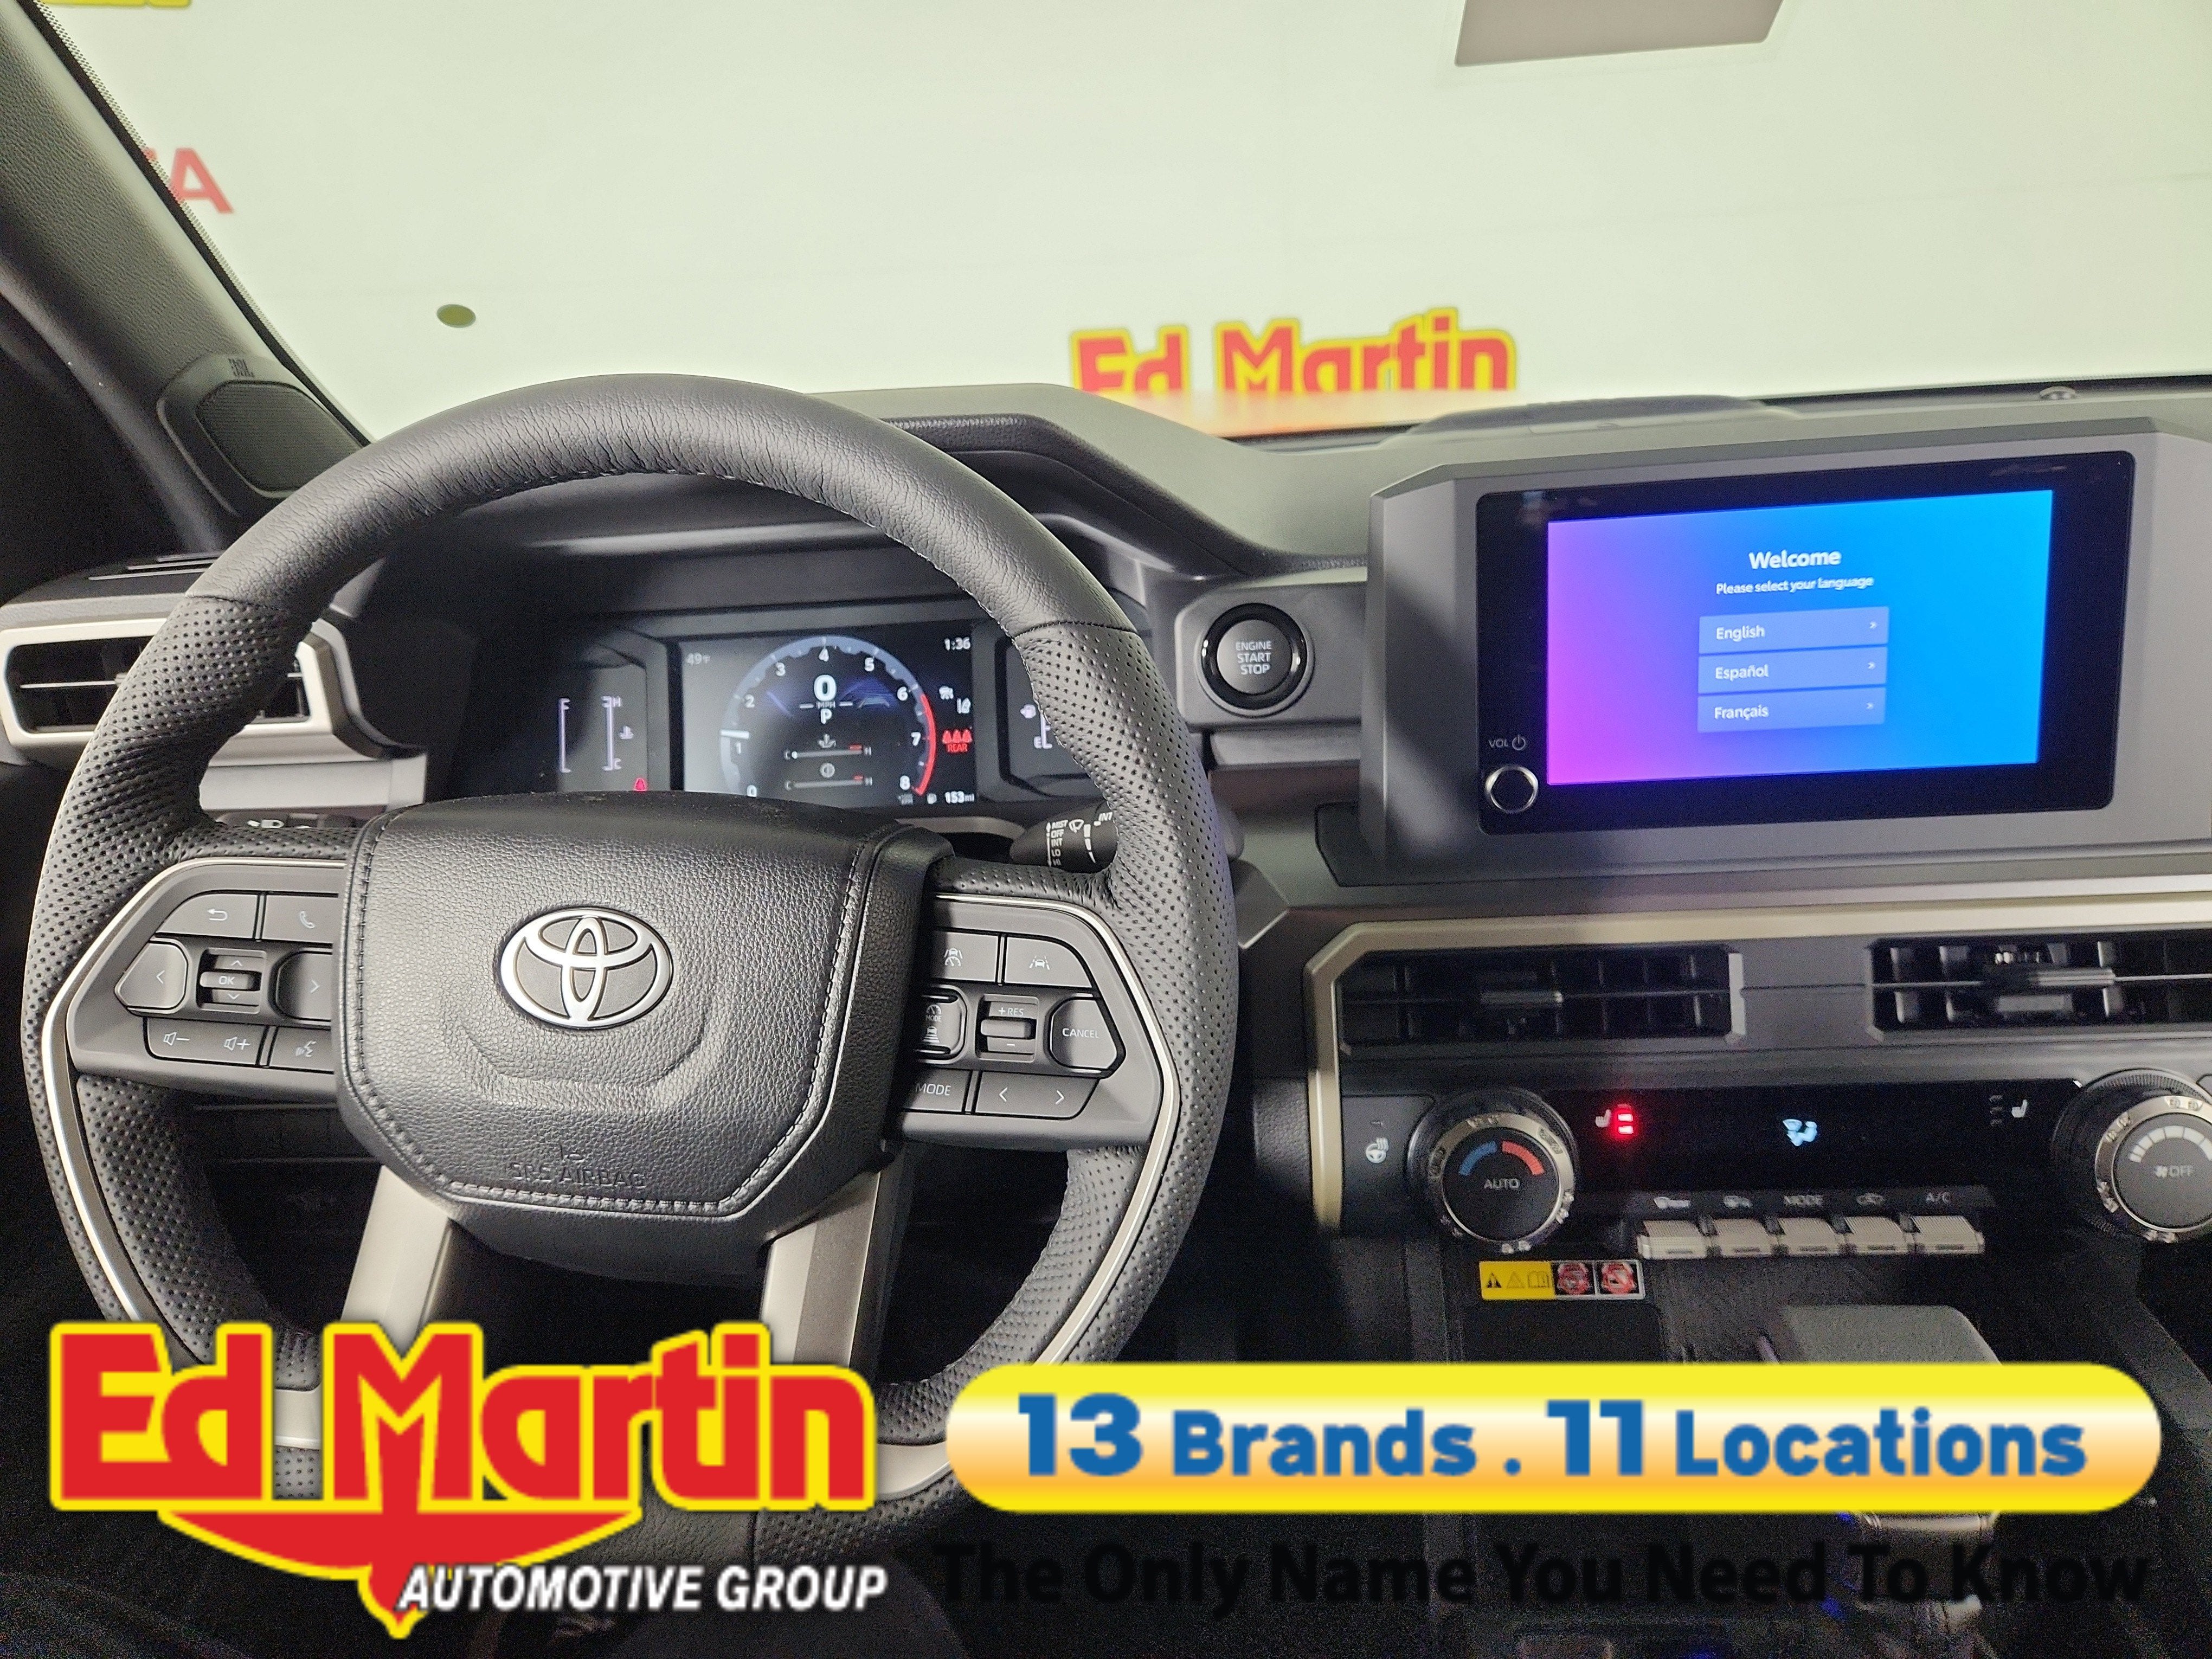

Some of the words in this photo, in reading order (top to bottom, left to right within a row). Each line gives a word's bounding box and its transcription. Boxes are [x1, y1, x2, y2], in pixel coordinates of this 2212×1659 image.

[1072, 326, 1188, 395] Ed
[1216, 310, 1516, 393] Martin
[1748, 549, 1842, 569] Welcome
[1716, 583, 1753, 595] Please
[1754, 580, 1789, 593] select
[1790, 578, 1816, 593] your
[1817, 577, 1875, 591] language
[1715, 625, 1765, 642] English
[944, 637, 970, 650] 1:36
[1236, 641, 1272, 651] ENGINE
[819, 647, 829, 662] 4
[1237, 652, 1271, 664] START
[775, 662, 786, 677] 3
[864, 658, 874, 672] 5
[1240, 664, 1270, 675] STOP
[1714, 664, 1769, 681] Español
[814, 674, 837, 702] 0
[897, 686, 908, 701] 6
[745, 694, 755, 708] 2
[820, 709, 832, 724] P
[1714, 704, 1769, 720] Français
[911, 732, 921, 747] 7
[1488, 738, 1509, 748] VOL
[736, 741, 742, 754] 1
[948, 743, 968, 753] REAR
[899, 775, 910, 790] 8
[746, 785, 758, 798] 0
[1052, 820, 1069, 829] MIST
[1051, 829, 1064, 838] OFF
[1051, 838, 1063, 847] INT
[1051, 848, 1061, 857] LO
[218, 976, 235, 985] OK
[925, 1015, 942, 1023] MODE
[1062, 1028, 1099, 1038] CANCEL
[915, 1083, 951, 1096] MODE
[558, 1166, 646, 1189] AIRBAG
[2168, 1165, 2194, 1178] OFF
[1484, 1178, 1520, 1190] AUTO
